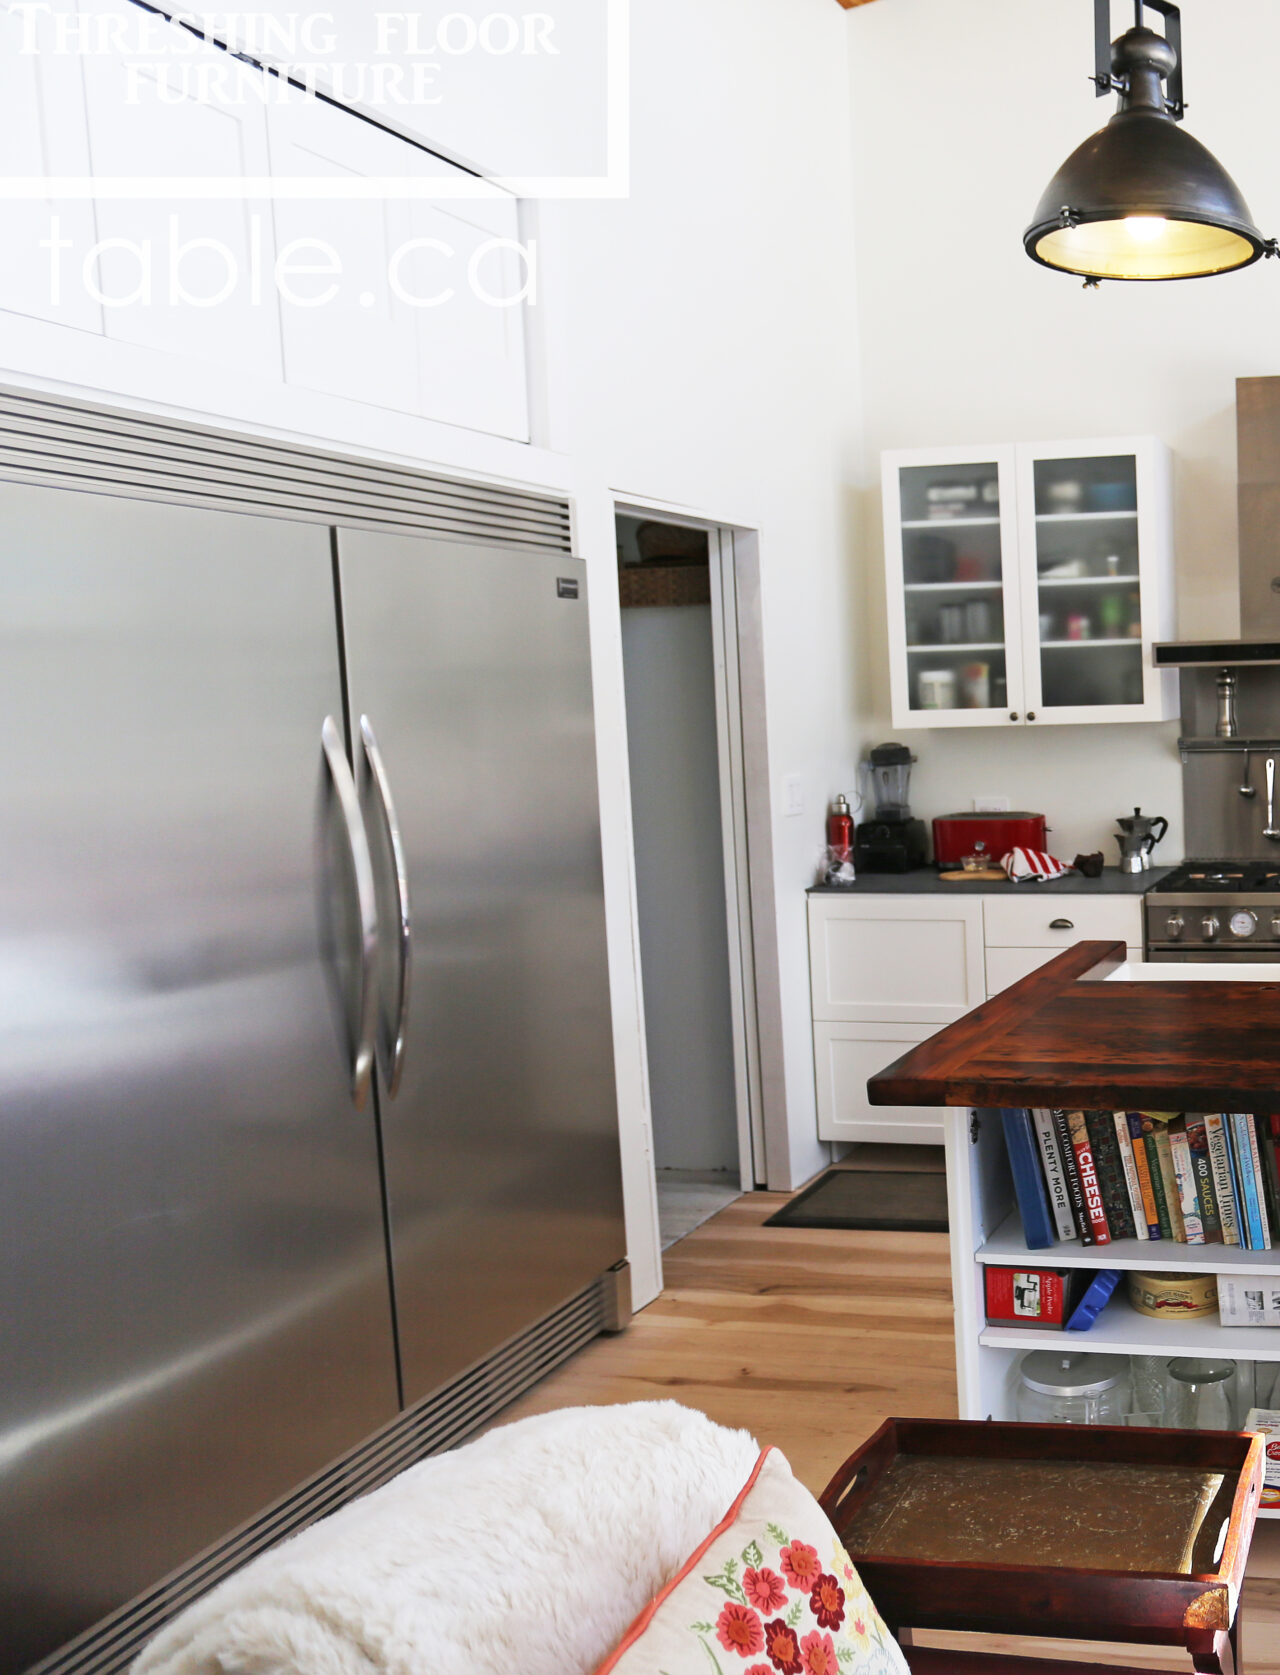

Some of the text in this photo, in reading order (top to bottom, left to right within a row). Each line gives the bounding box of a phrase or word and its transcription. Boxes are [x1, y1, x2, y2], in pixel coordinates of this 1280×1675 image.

[1042, 1131, 1059, 1174] PLENTY
[1052, 1177, 1066, 1209] MORE
[1061, 1131, 1077, 1176] COMFORT
[1071, 1178, 1082, 1208] FOODS
[1079, 1151, 1105, 1219] CHEESE
[1197, 1158, 1214, 1216] 400 SAUCES
[1210, 1127, 1230, 1191] Vegetarian
[1221, 1191, 1235, 1228] Times
[1045, 1275, 1054, 1315] Apple Peeler
